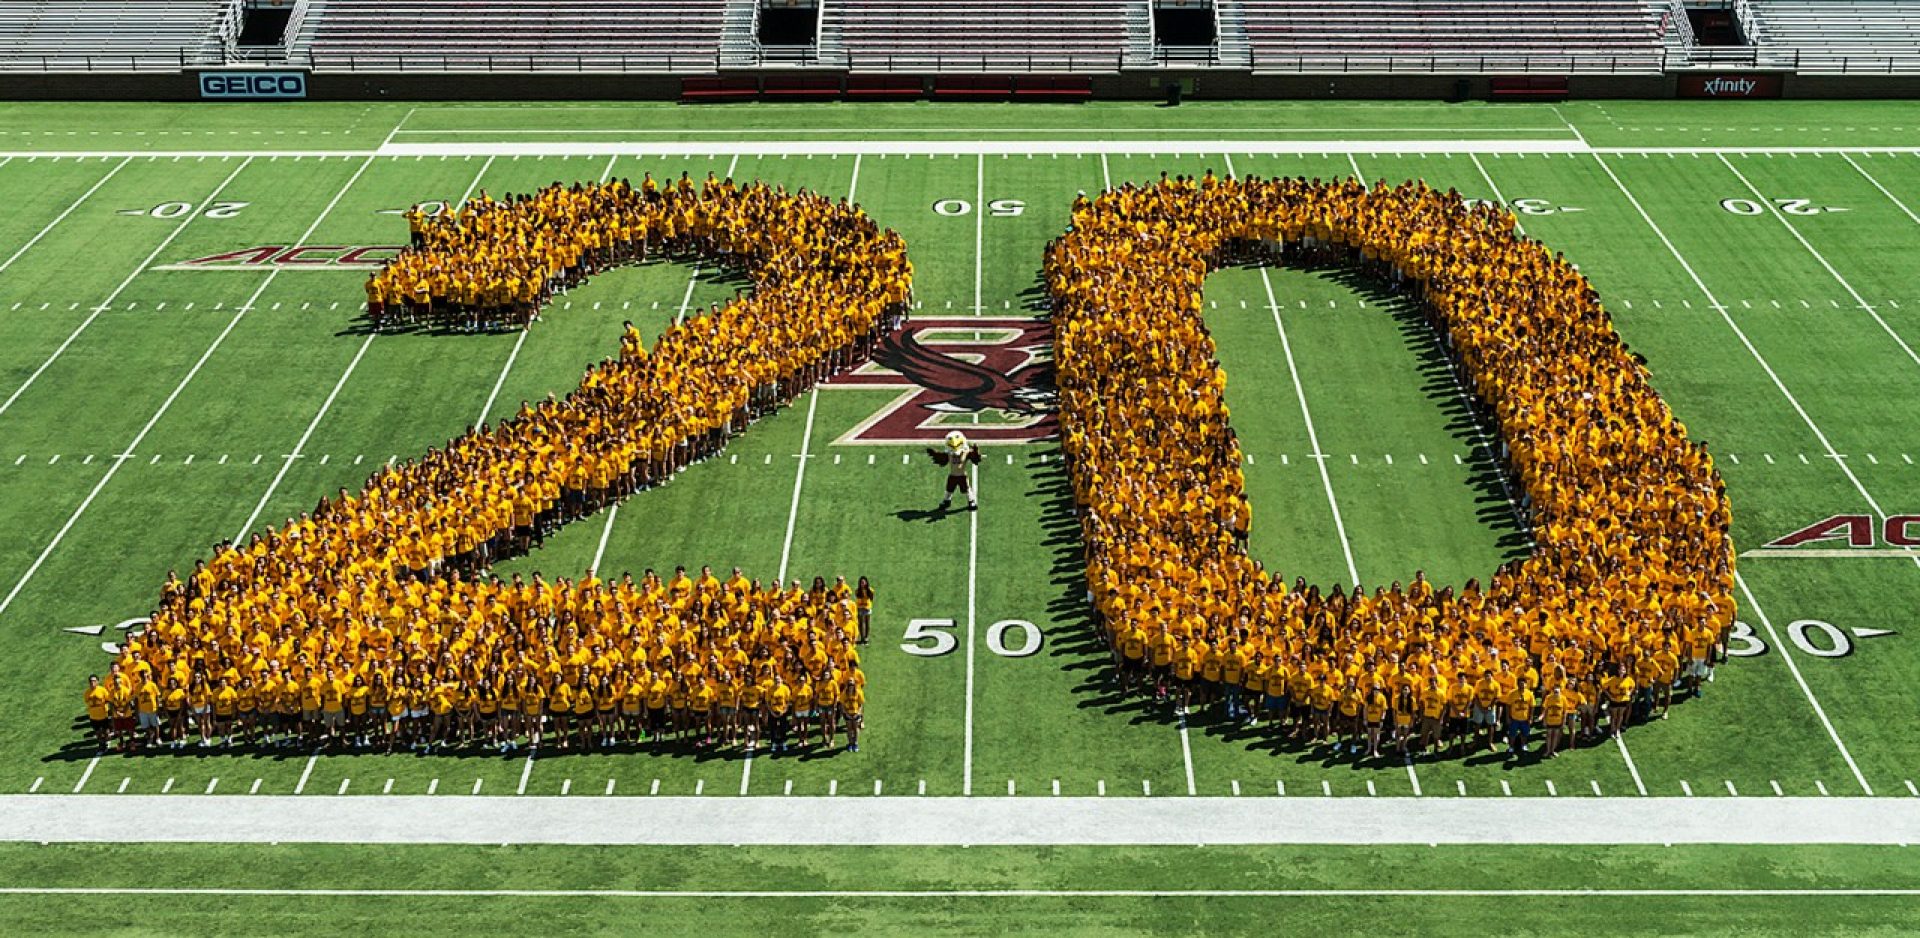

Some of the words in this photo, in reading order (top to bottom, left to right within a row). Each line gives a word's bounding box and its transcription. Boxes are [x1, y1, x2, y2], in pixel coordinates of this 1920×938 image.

[203, 76, 302, 93] GEICO
[1704, 77, 1756, 95] xfinity
[149, 200, 250, 219] 20
[932, 198, 1027, 217] 50
[1720, 198, 1820, 215] 20
[177, 244, 404, 265] ACC
[899, 618, 1045, 657] 50
